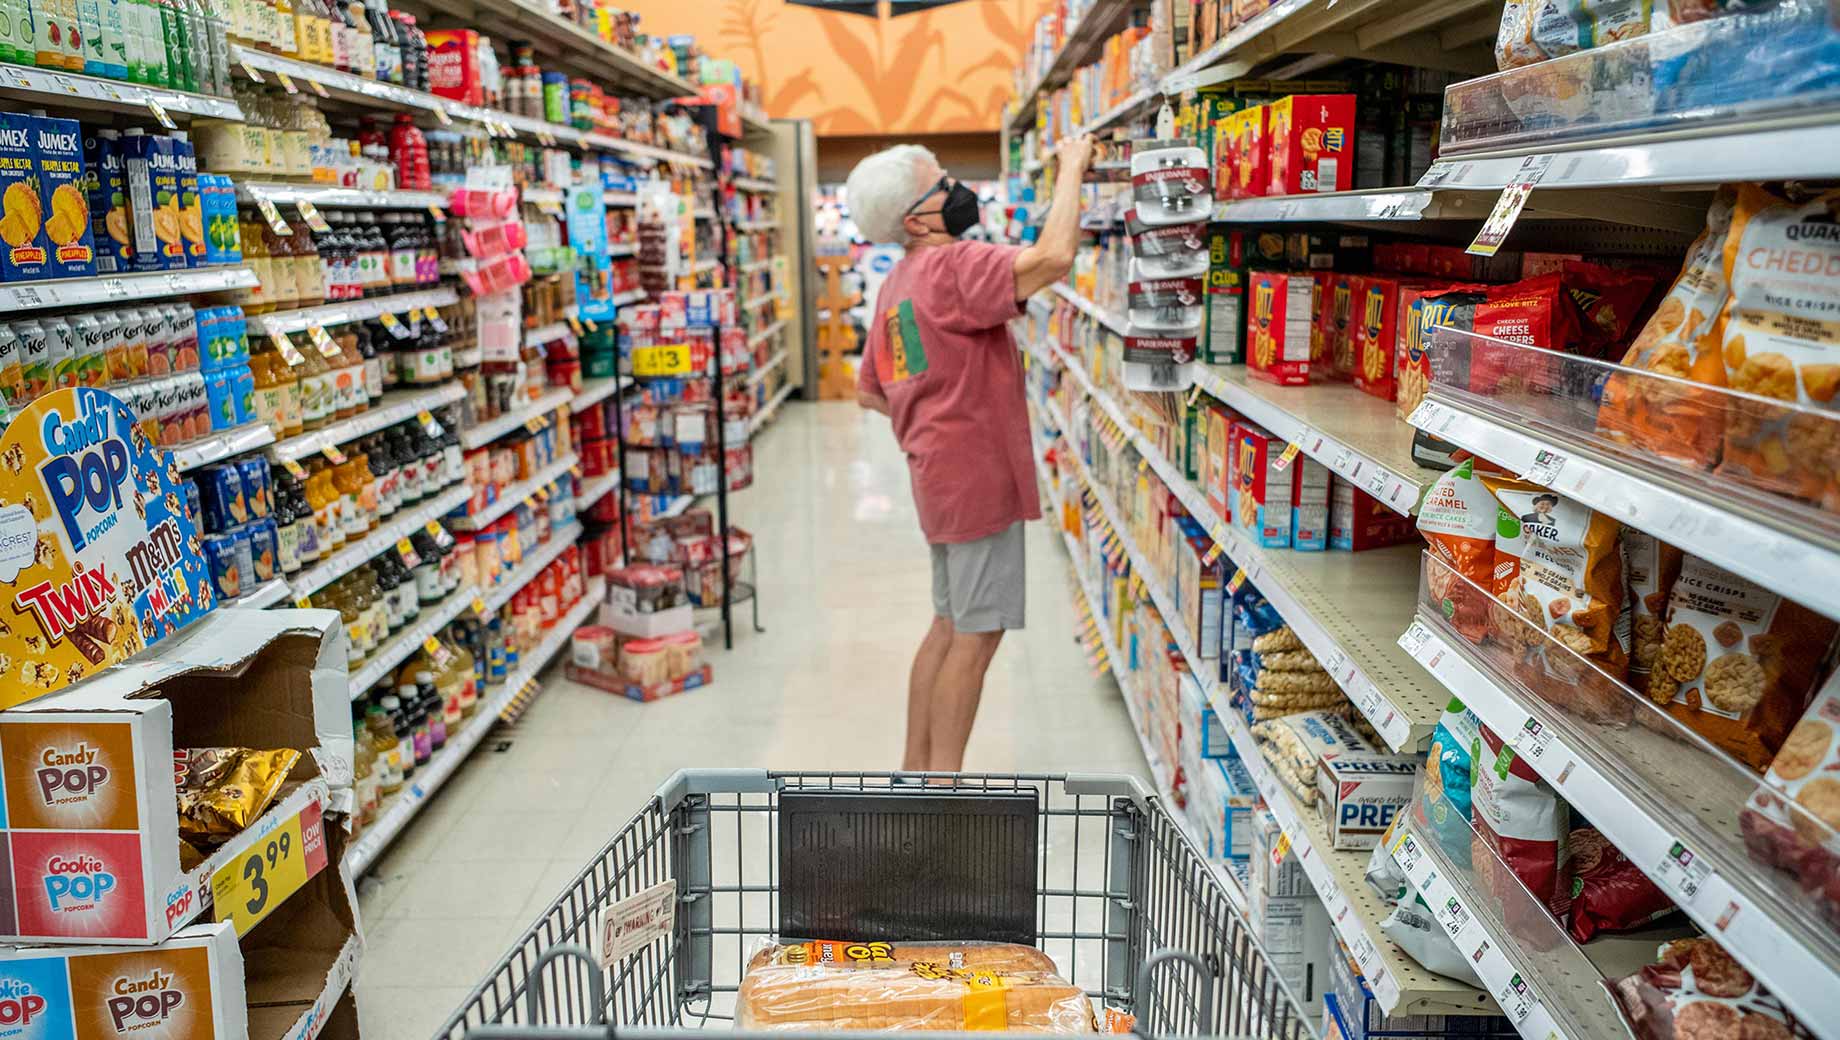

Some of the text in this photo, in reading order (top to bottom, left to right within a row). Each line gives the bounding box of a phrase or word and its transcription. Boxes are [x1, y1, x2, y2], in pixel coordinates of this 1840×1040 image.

[0, 129, 30, 147] MEX
[38, 130, 78, 151] JUMEX
[1327, 127, 1344, 153] RITZ
[1786, 224, 1840, 241] QUAK
[1747, 247, 1840, 277] CHEDD
[1522, 300, 1538, 308] RITZ
[1765, 294, 1791, 305] RICE
[1365, 289, 1385, 330] RITZ
[1421, 304, 1457, 330] RITZ
[1492, 325, 1530, 336] CHEESE
[28, 336, 46, 356] Ker
[43, 392, 110, 455] Candy
[42, 442, 129, 553] POP
[86, 513, 119, 545] POPCORN
[0, 531, 32, 547] CREST
[1705, 583, 1747, 598] CRISPS
[1465, 708, 1482, 727] RAN
[43, 745, 96, 767] Candy
[1529, 742, 1544, 758] 1.99
[37, 766, 108, 804] POP
[56, 796, 88, 805] POPCORN
[1341, 803, 1399, 828] PRE
[302, 822, 320, 845] LOW
[304, 839, 321, 857] PRICE
[48, 856, 102, 875] Cookie
[44, 873, 115, 911] POP
[167, 884, 189, 906] Cookie
[1680, 878, 1697, 897] 1.99
[64, 904, 94, 913] POPCORN
[166, 890, 193, 929] POP
[1447, 921, 1460, 935] 2.49
[0, 980, 30, 999] okie
[115, 972, 169, 995] Candy
[0, 996, 44, 1025] OP
[108, 990, 183, 1032] POP
[1514, 1003, 1528, 1018] 1.99
[0, 1028, 23, 1038] PCORN
[128, 1020, 161, 1032] POPCORN
